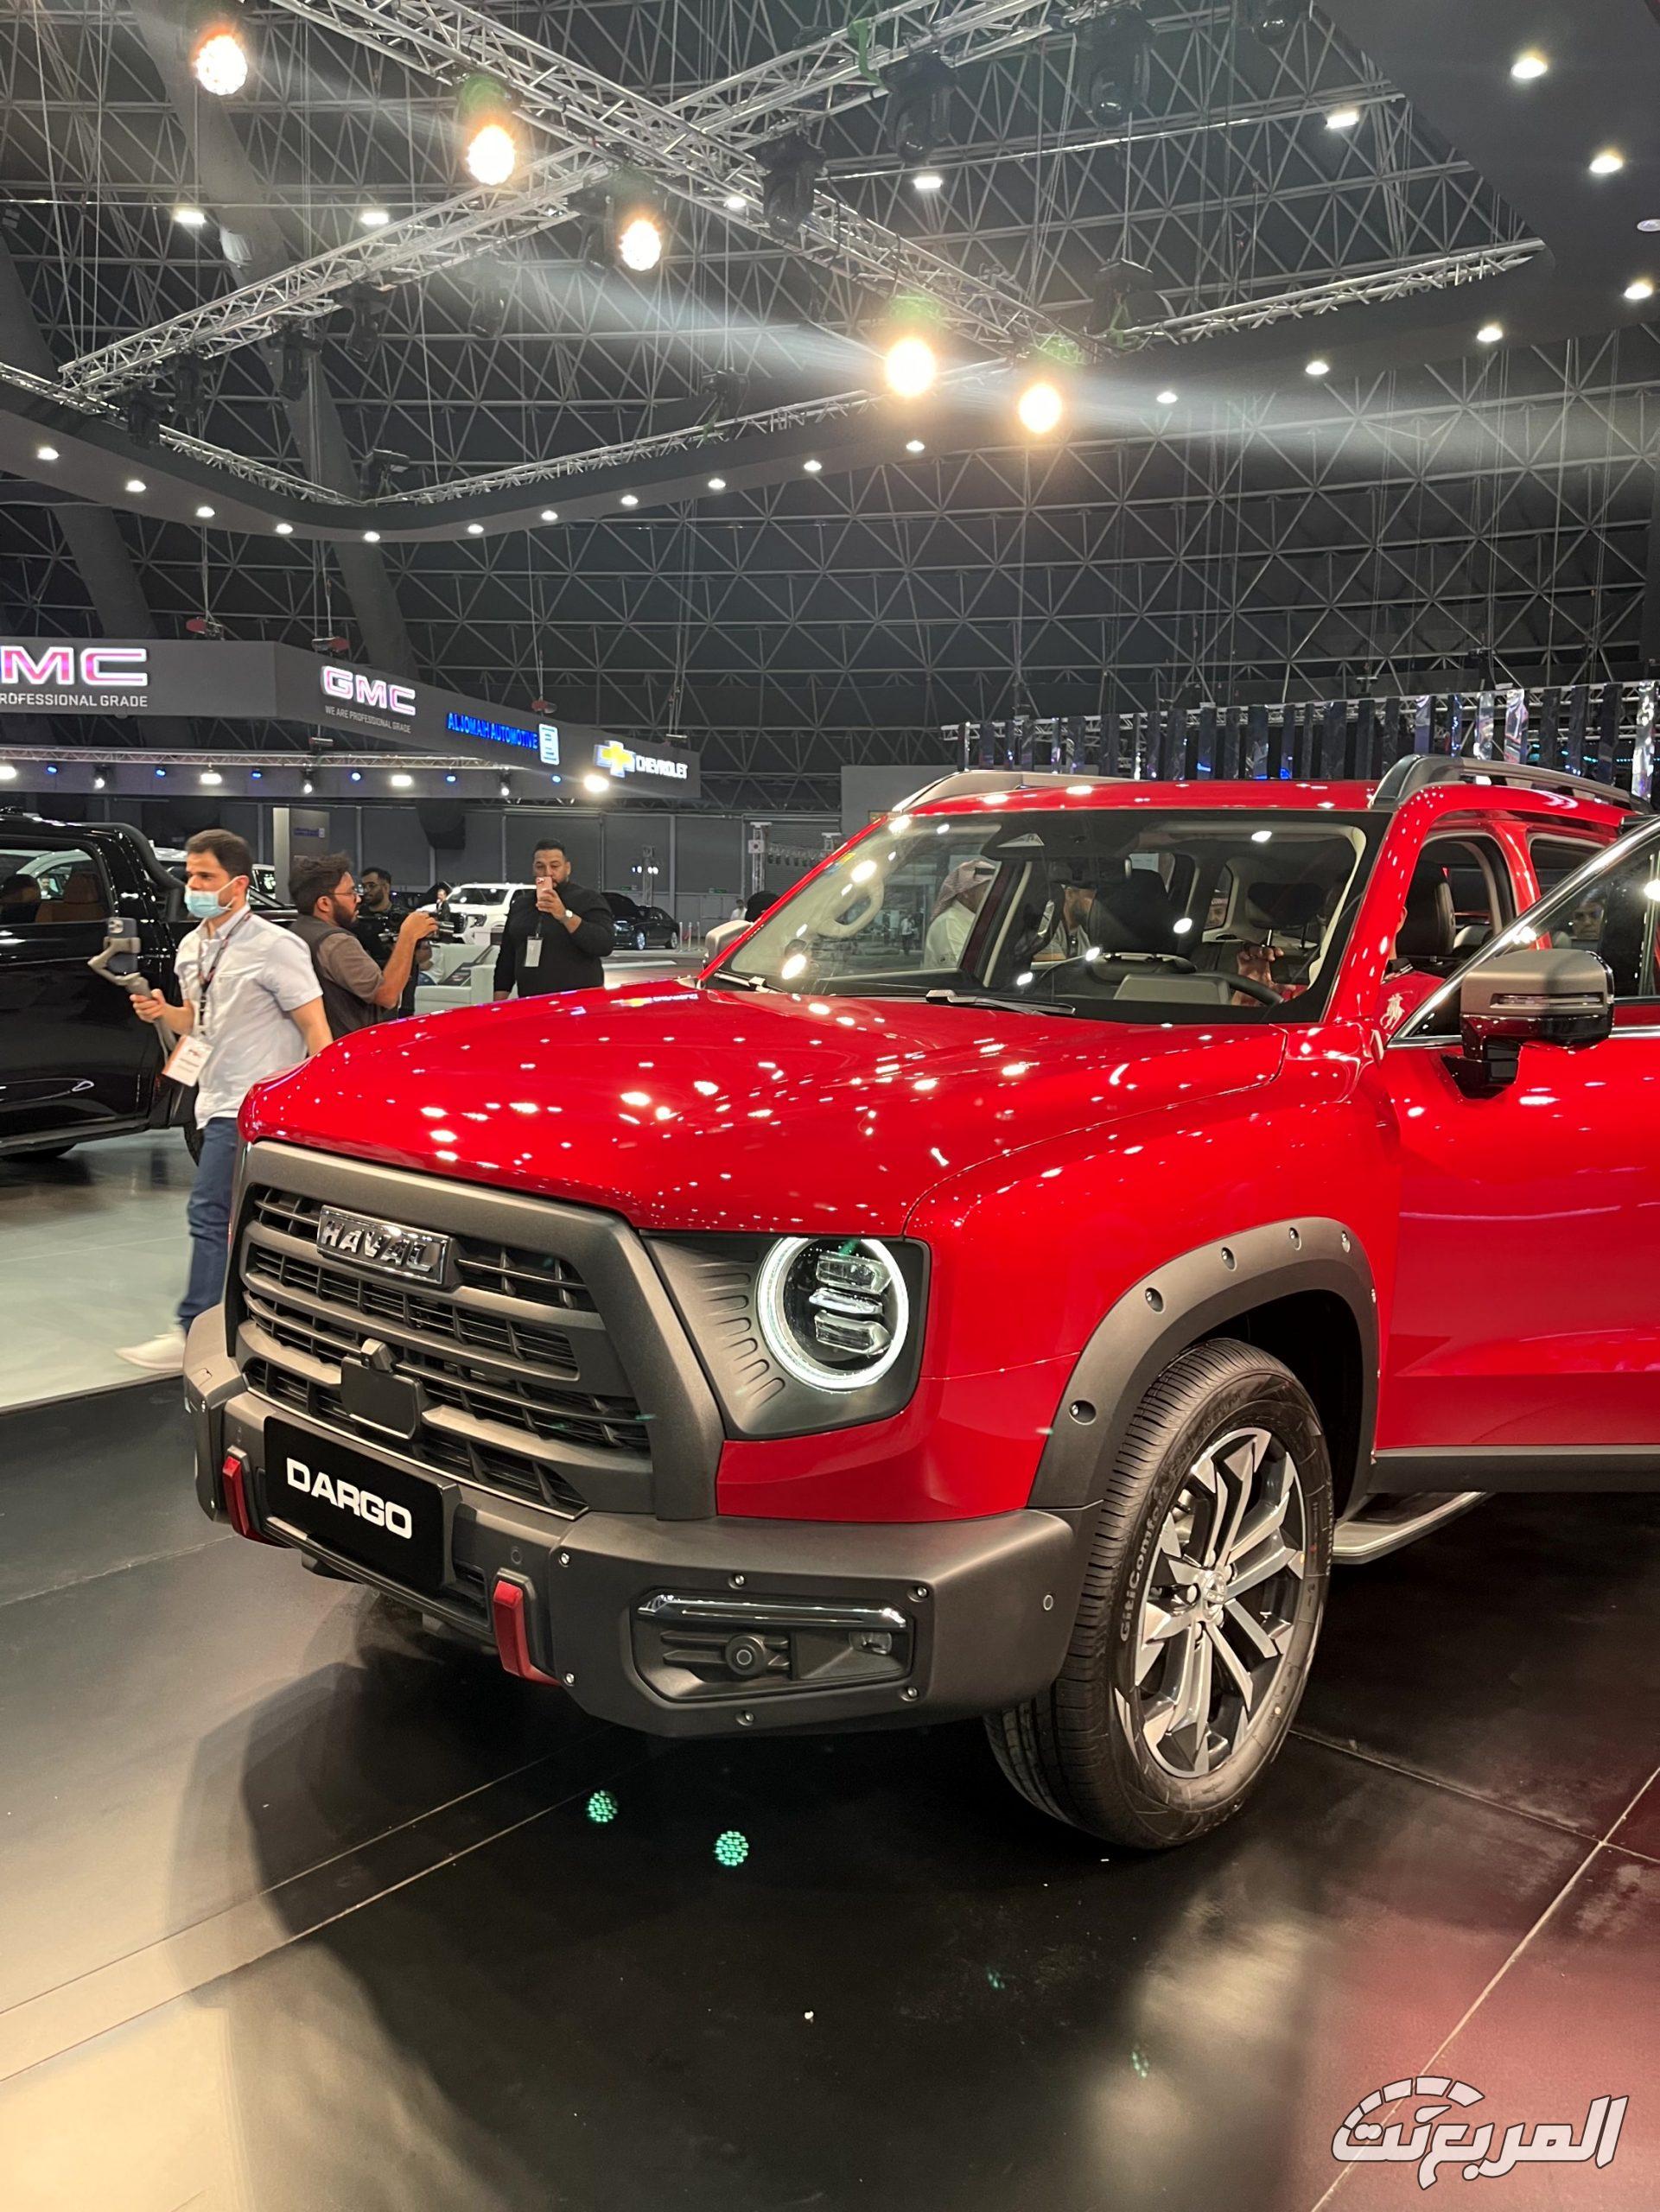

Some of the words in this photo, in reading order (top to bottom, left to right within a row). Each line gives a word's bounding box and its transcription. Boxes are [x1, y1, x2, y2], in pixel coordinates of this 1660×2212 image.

[0, 645, 148, 686] MC
[0, 692, 97, 707] ROFESSIONAL
[100, 695, 148, 708] GRADE
[321, 665, 416, 716] GMC
[325, 705, 335, 715] WE
[336, 708, 348, 719] ARE
[349, 711, 391, 728] PROFESSIONAL
[635, 754, 688, 779] CHEVROLET
[321, 1219, 433, 1273] HAVAL
[286, 1457, 412, 1540] DARGO
